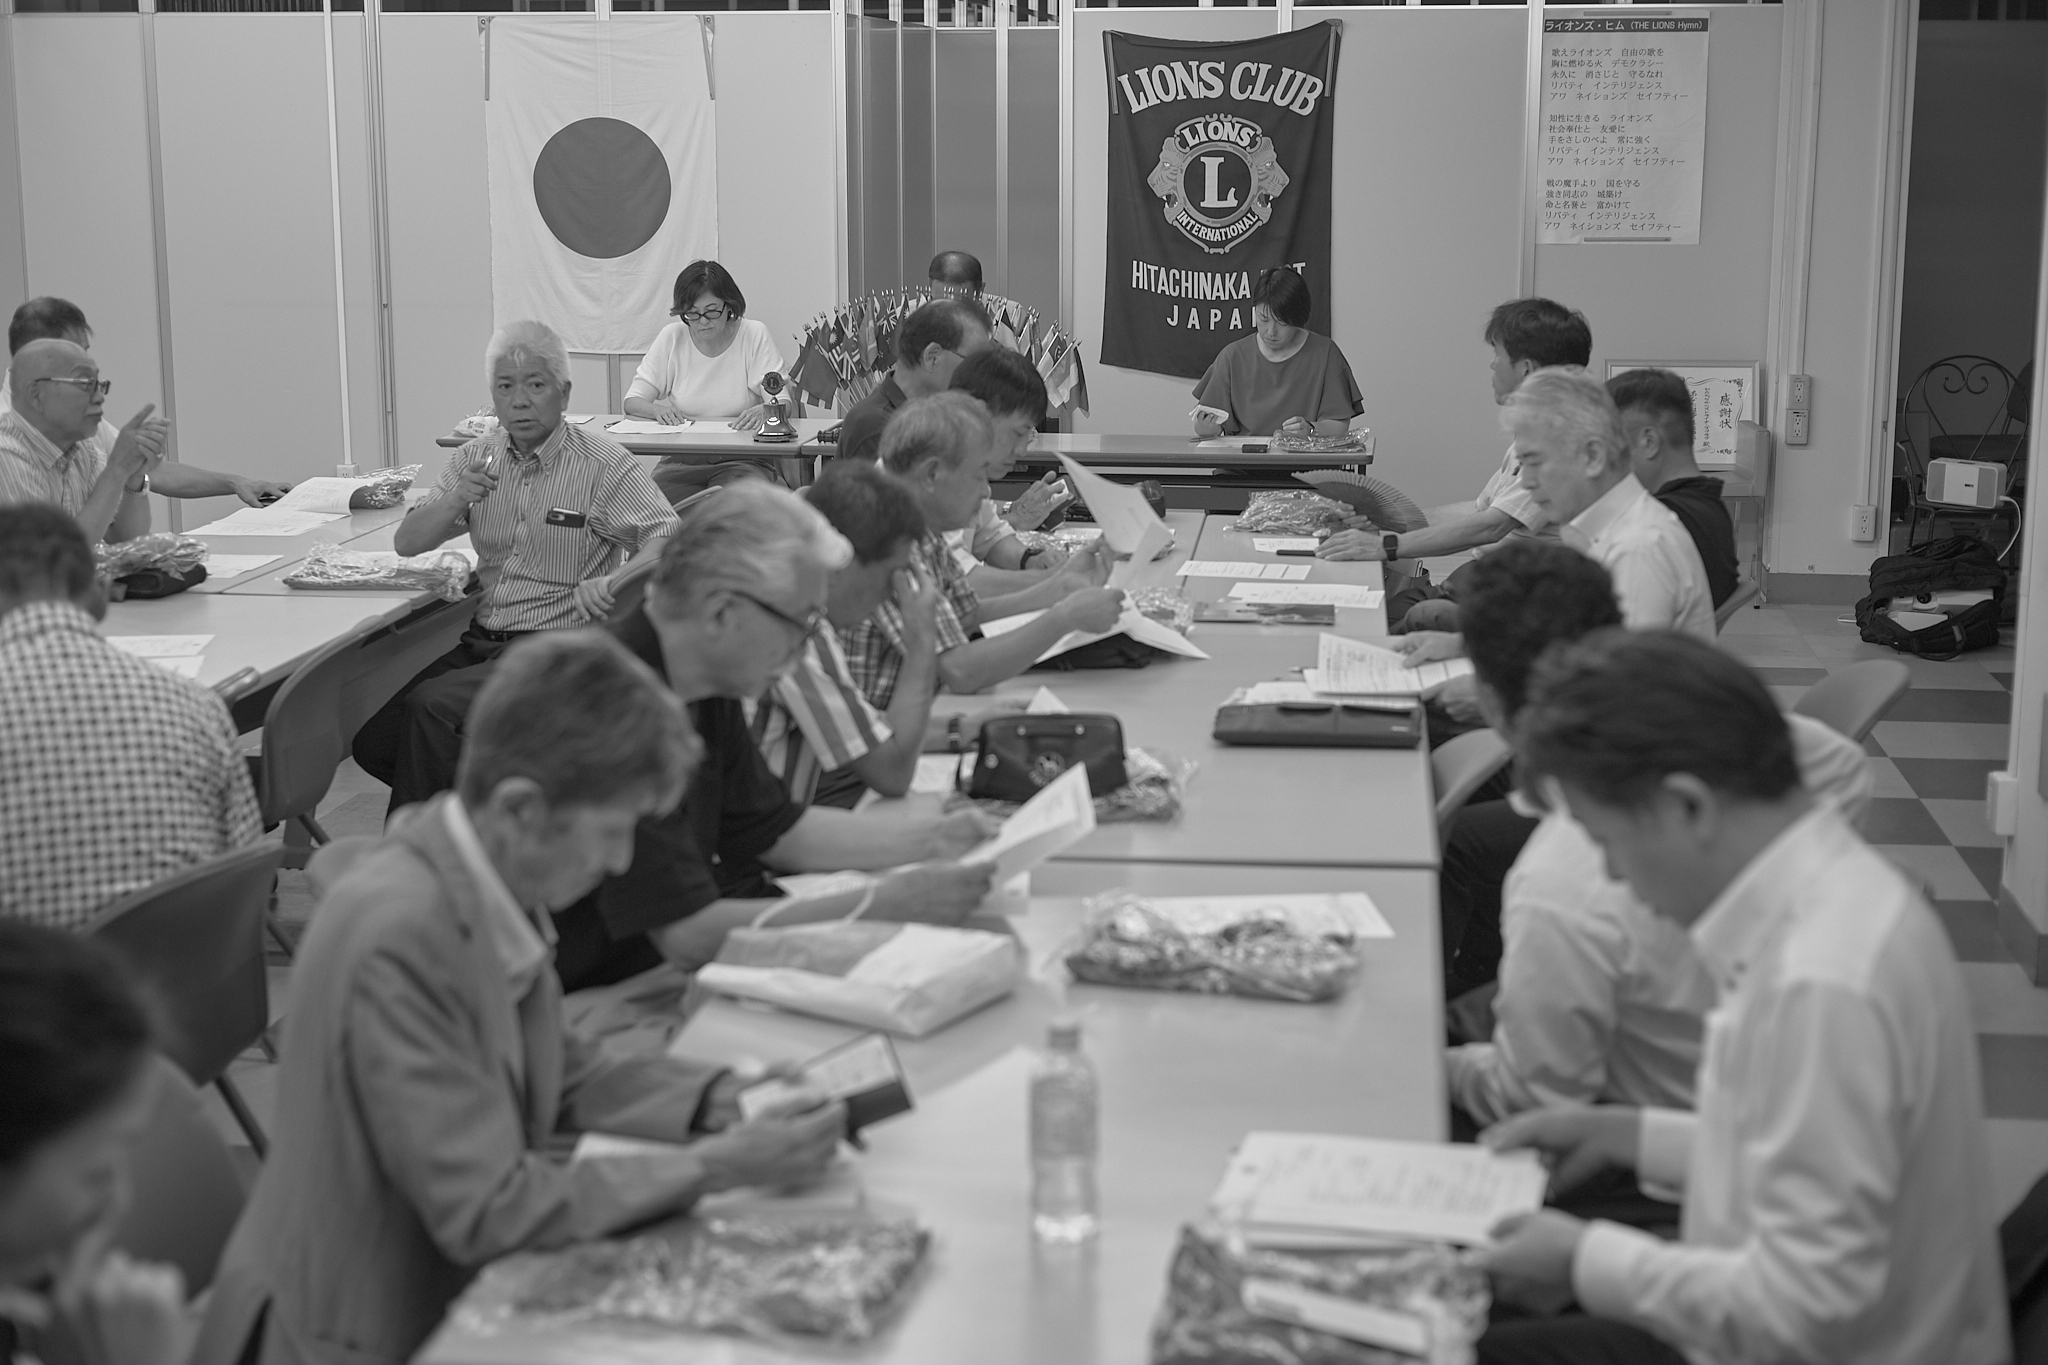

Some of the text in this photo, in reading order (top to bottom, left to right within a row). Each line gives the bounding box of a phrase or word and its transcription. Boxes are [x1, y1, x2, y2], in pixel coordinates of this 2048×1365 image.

[1652, 21, 1675, 29] LIONS
[1552, 48, 1664, 57] 歌えライオンズ 自由の歌を
[1612, 59, 1663, 67] デモクラシー
[1551, 70, 1575, 79] 永久に
[1629, 70, 1662, 79] 守るなれ
[1117, 60, 1325, 116] LIONS CLUB
[1594, 81, 1662, 89] インテリジェンス
[1576, 92, 1628, 100] ネイションズ
[1637, 92, 1688, 100] セイフティー
[1549, 114, 1653, 122] 知性に生きる ライオンズ
[1600, 125, 1625, 133] 友愛に
[1181, 121, 1257, 147] LIONS
[1549, 136, 1650, 144] 手をさしのべよ 常に強く
[1591, 147, 1659, 155] インテリジェンス
[1574, 157, 1625, 165] ネイションズ
[1634, 158, 1685, 166] セイフティー
[1200, 156, 1238, 208] L
[1606, 179, 1640, 188] 国を守る
[1546, 200, 1586, 209] 命と名誉と
[1588, 212, 1655, 220] インテリジェンス
[1176, 211, 1259, 242] INTERNATIONAL
[1570, 222, 1621, 230] ネイションズ
[1630, 223, 1680, 231] セイフティー
[1131, 260, 1251, 300] HITACHINAKA
[1719, 392, 1733, 429] 感謝状
